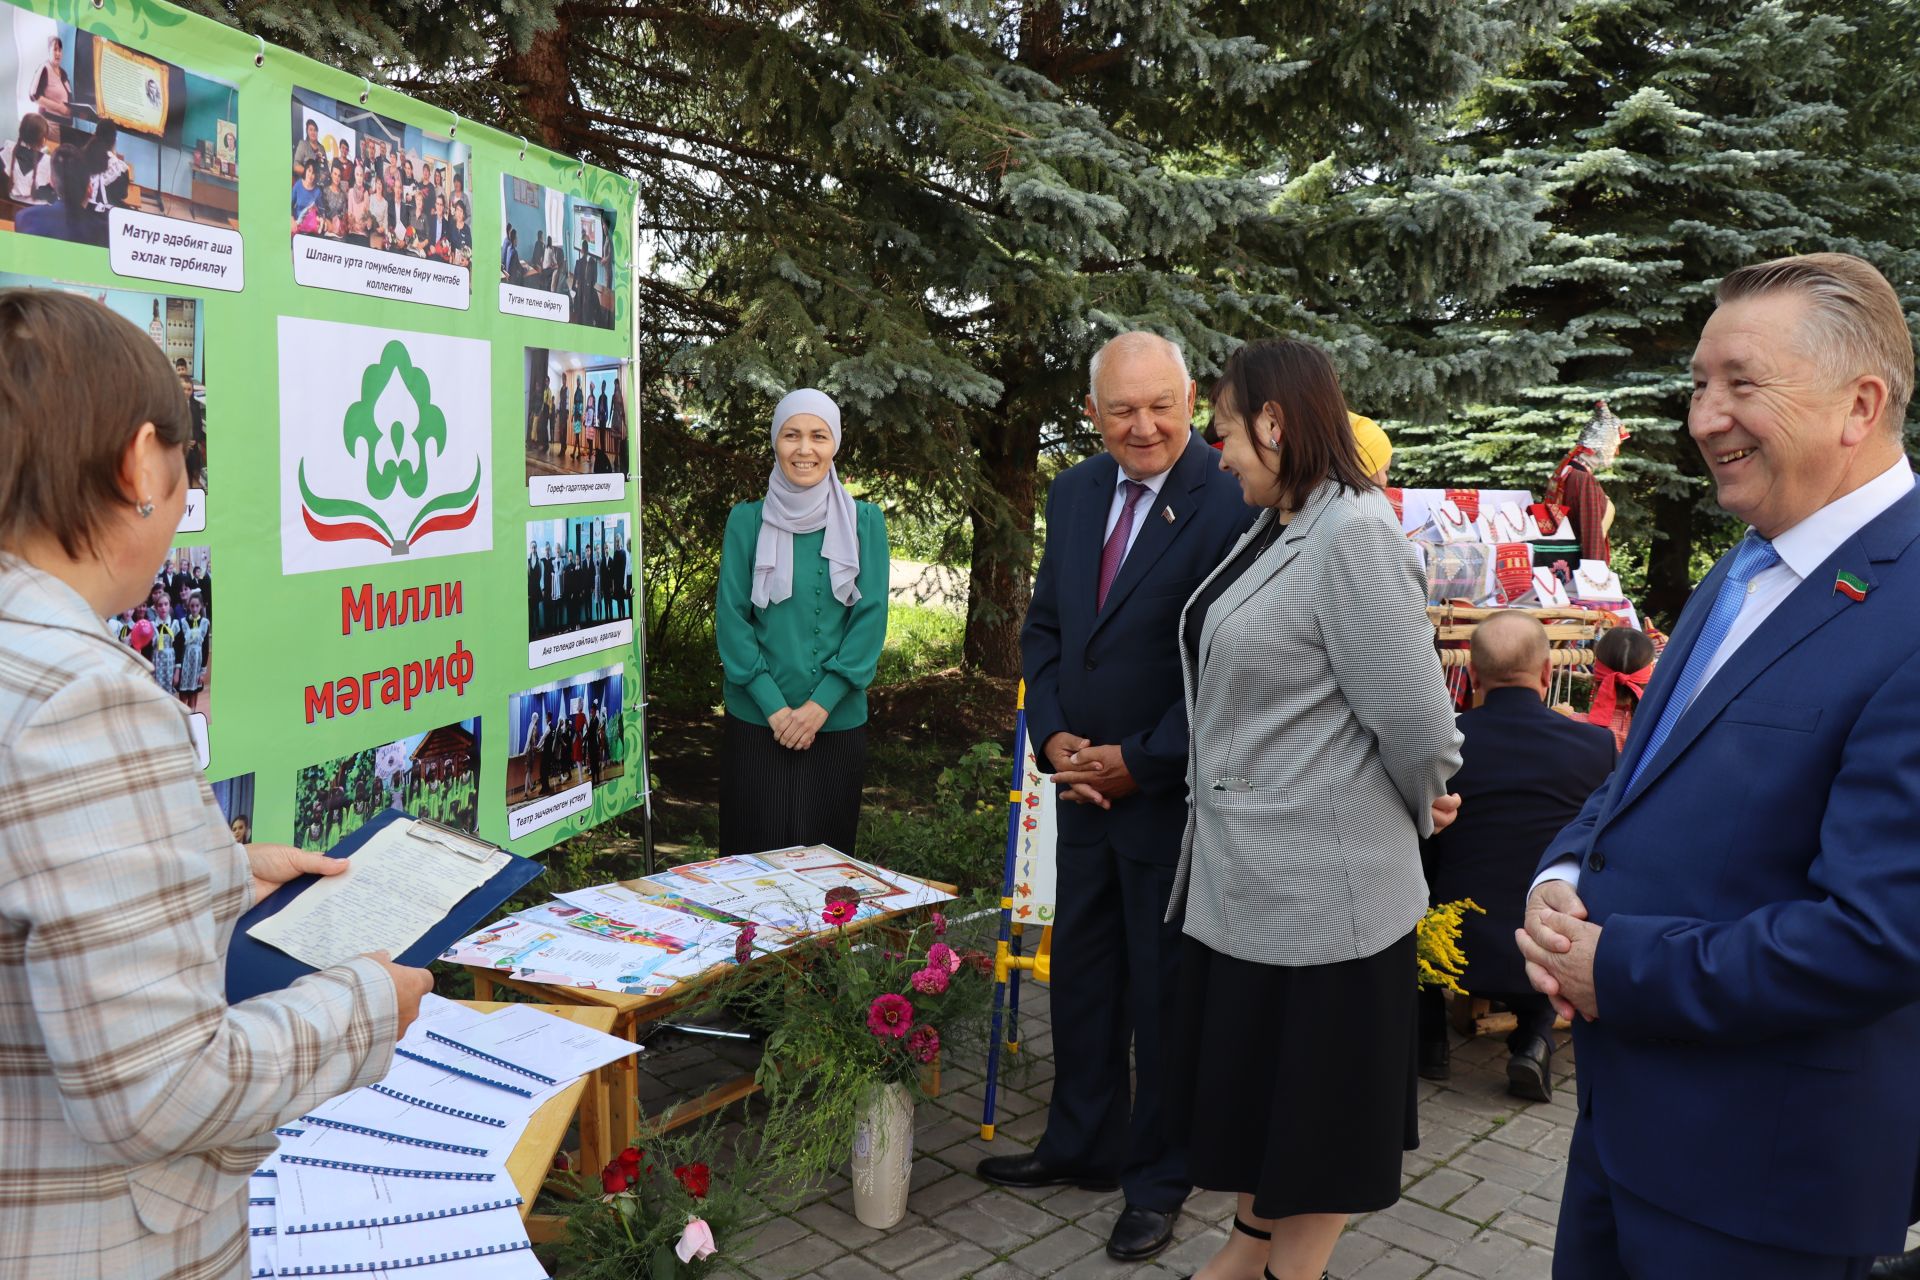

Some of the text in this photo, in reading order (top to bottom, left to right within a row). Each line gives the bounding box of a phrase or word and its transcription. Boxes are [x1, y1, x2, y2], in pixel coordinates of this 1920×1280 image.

[122, 223, 233, 255] Матур әдәбият аша
[131, 250, 228, 278] әхлак тәрбияләү
[306, 247, 342, 264] Шланга
[344, 256, 363, 269] урта
[364, 260, 411, 277] гомумбелем
[433, 273, 460, 286] мәктәбе
[366, 279, 413, 295] коллективы
[508, 292, 525, 305] Туган
[341, 580, 464, 636] Милли
[304, 640, 475, 725] мәгариф
[516, 813, 534, 828] Театр
